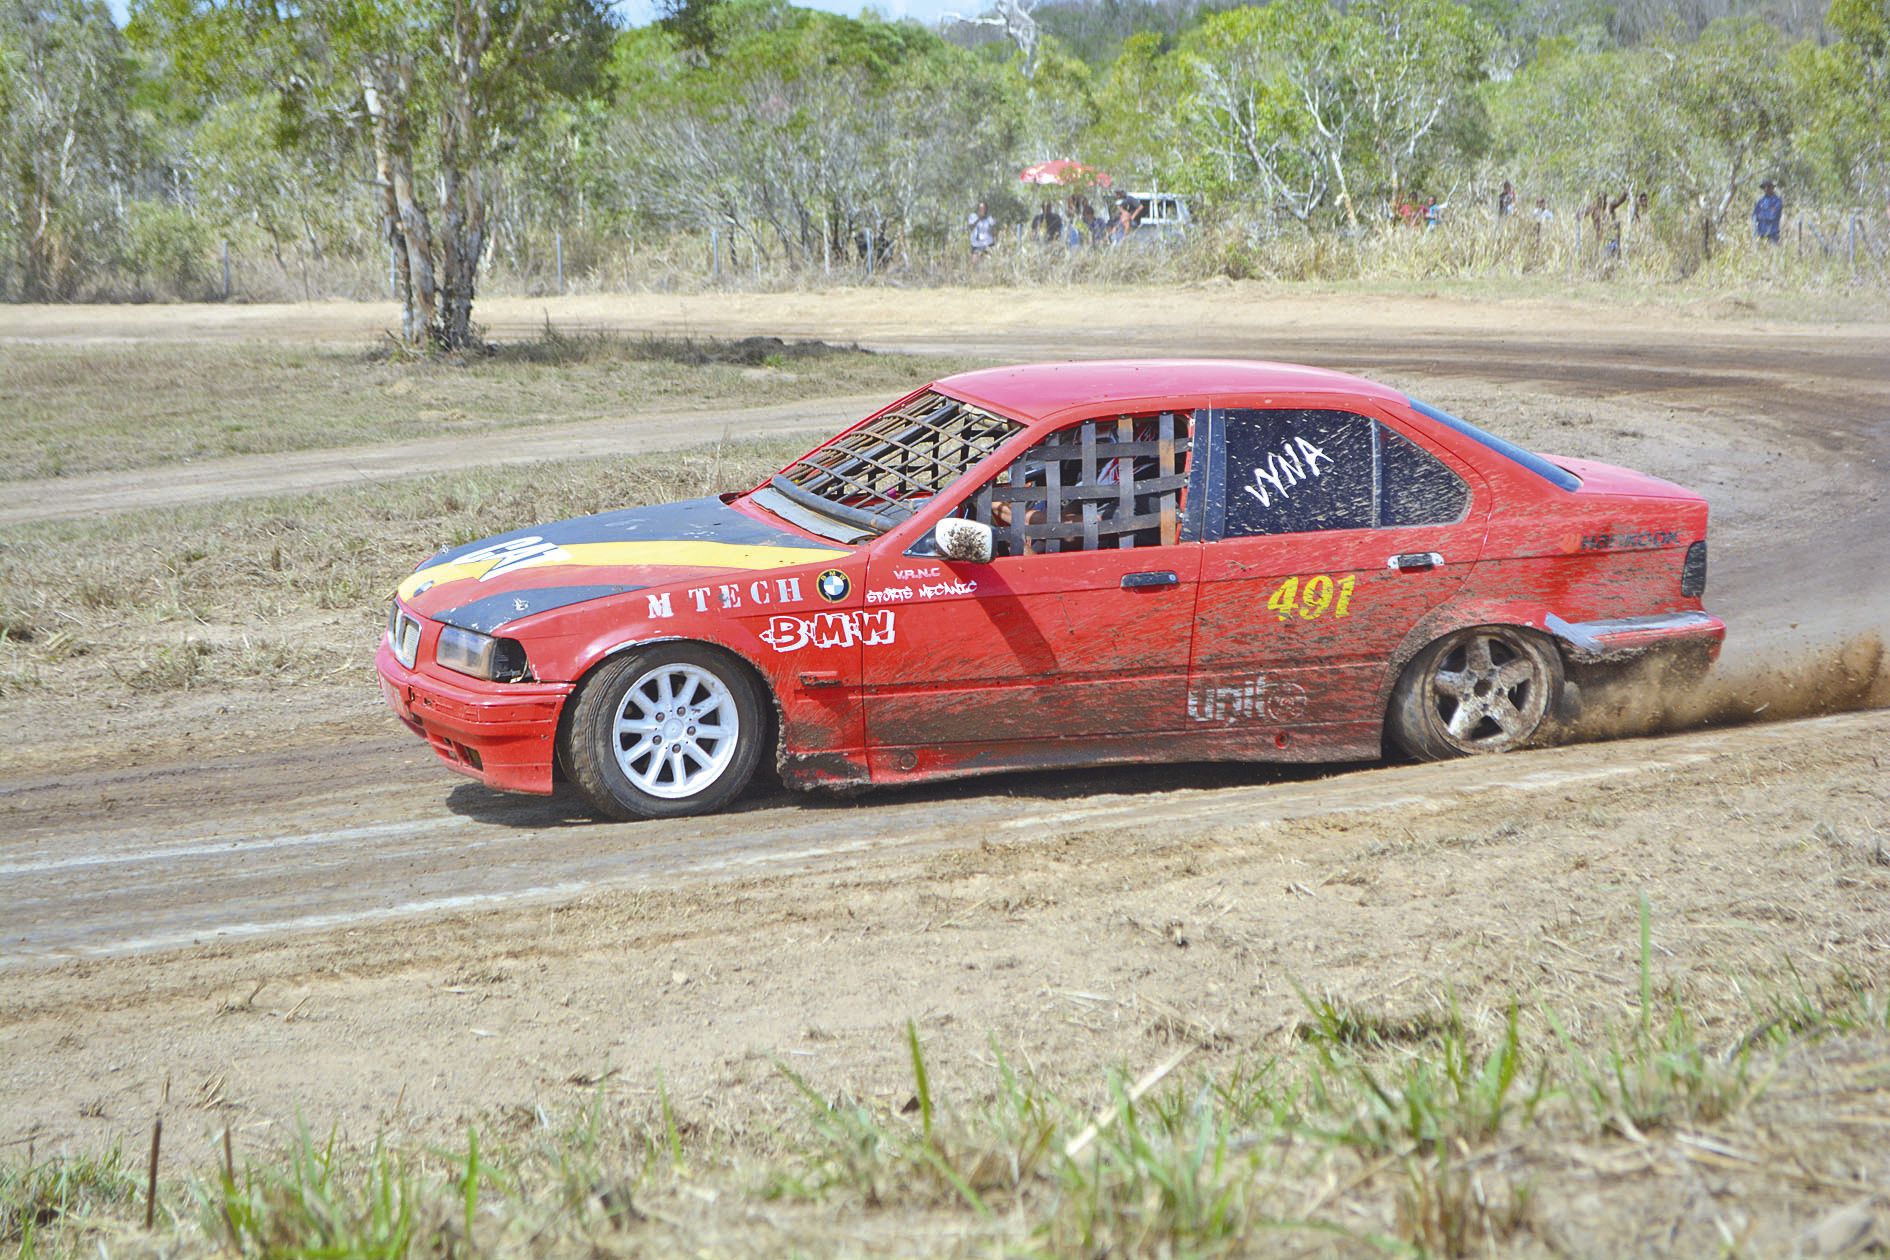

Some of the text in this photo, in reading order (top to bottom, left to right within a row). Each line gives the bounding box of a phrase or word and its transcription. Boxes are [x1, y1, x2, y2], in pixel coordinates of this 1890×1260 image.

[646, 577, 803, 618] M TECH
[866, 585, 914, 603] SPORTS
[1267, 574, 1356, 622] 491
[759, 609, 896, 653] BMW
